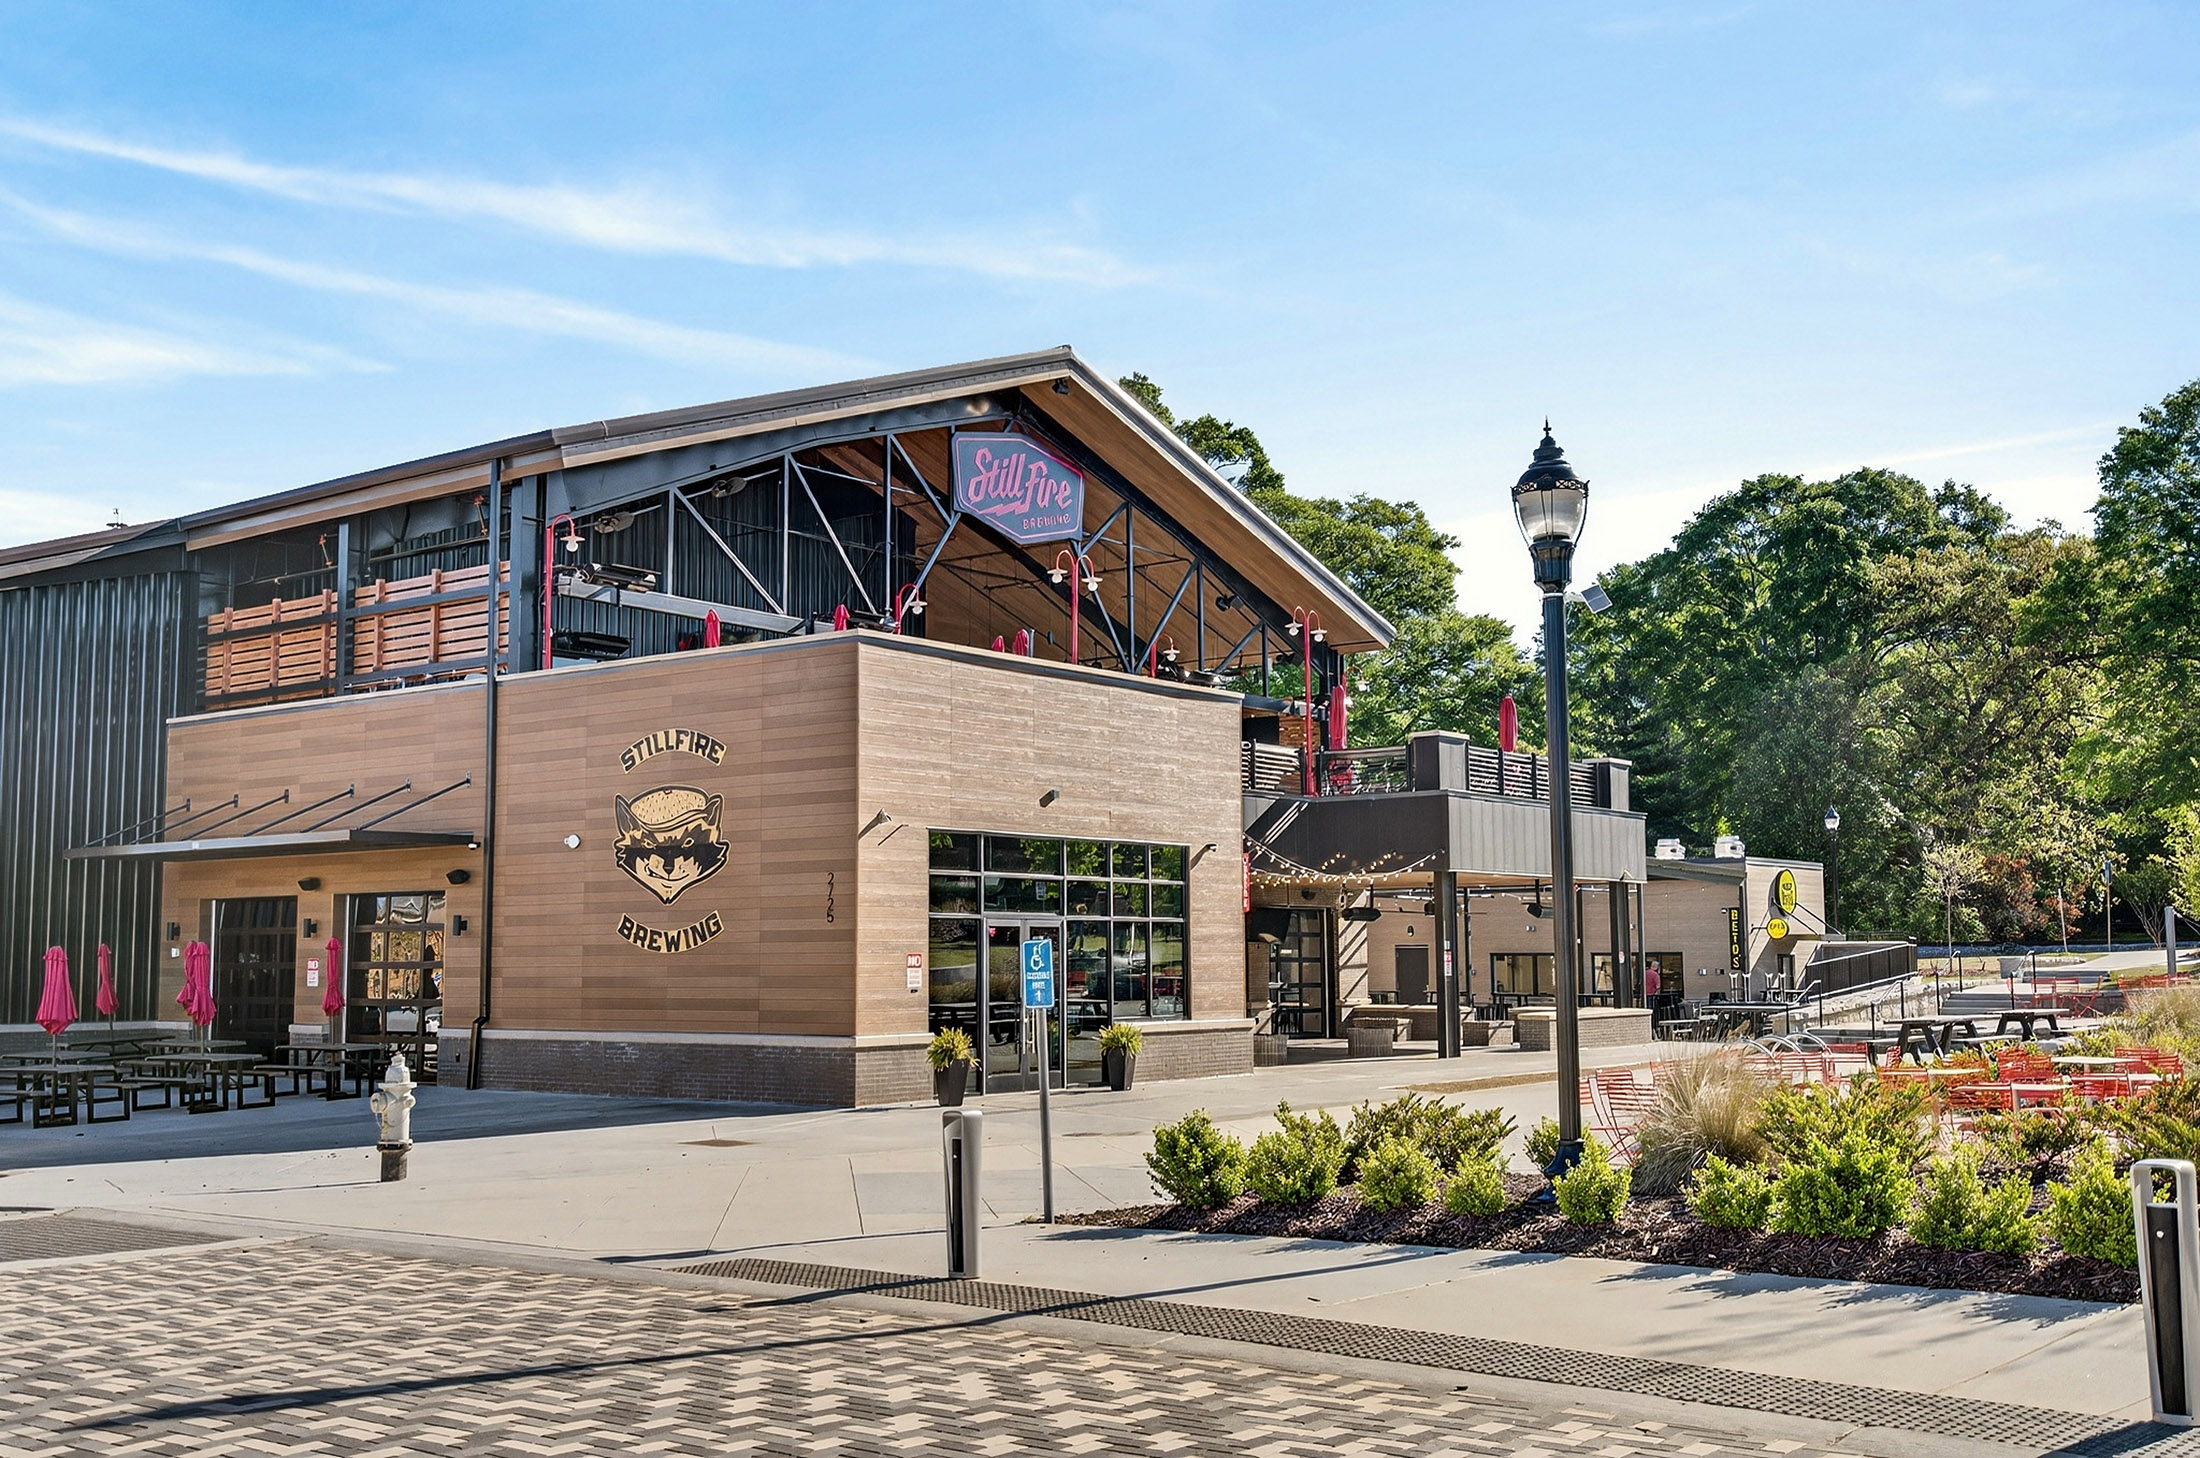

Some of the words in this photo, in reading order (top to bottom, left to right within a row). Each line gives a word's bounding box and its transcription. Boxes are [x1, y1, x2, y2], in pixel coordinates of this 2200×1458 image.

[620, 729, 726, 773] STILLFIRE
[827, 871, 835, 923] 2725
[617, 912, 724, 953] BREWING
